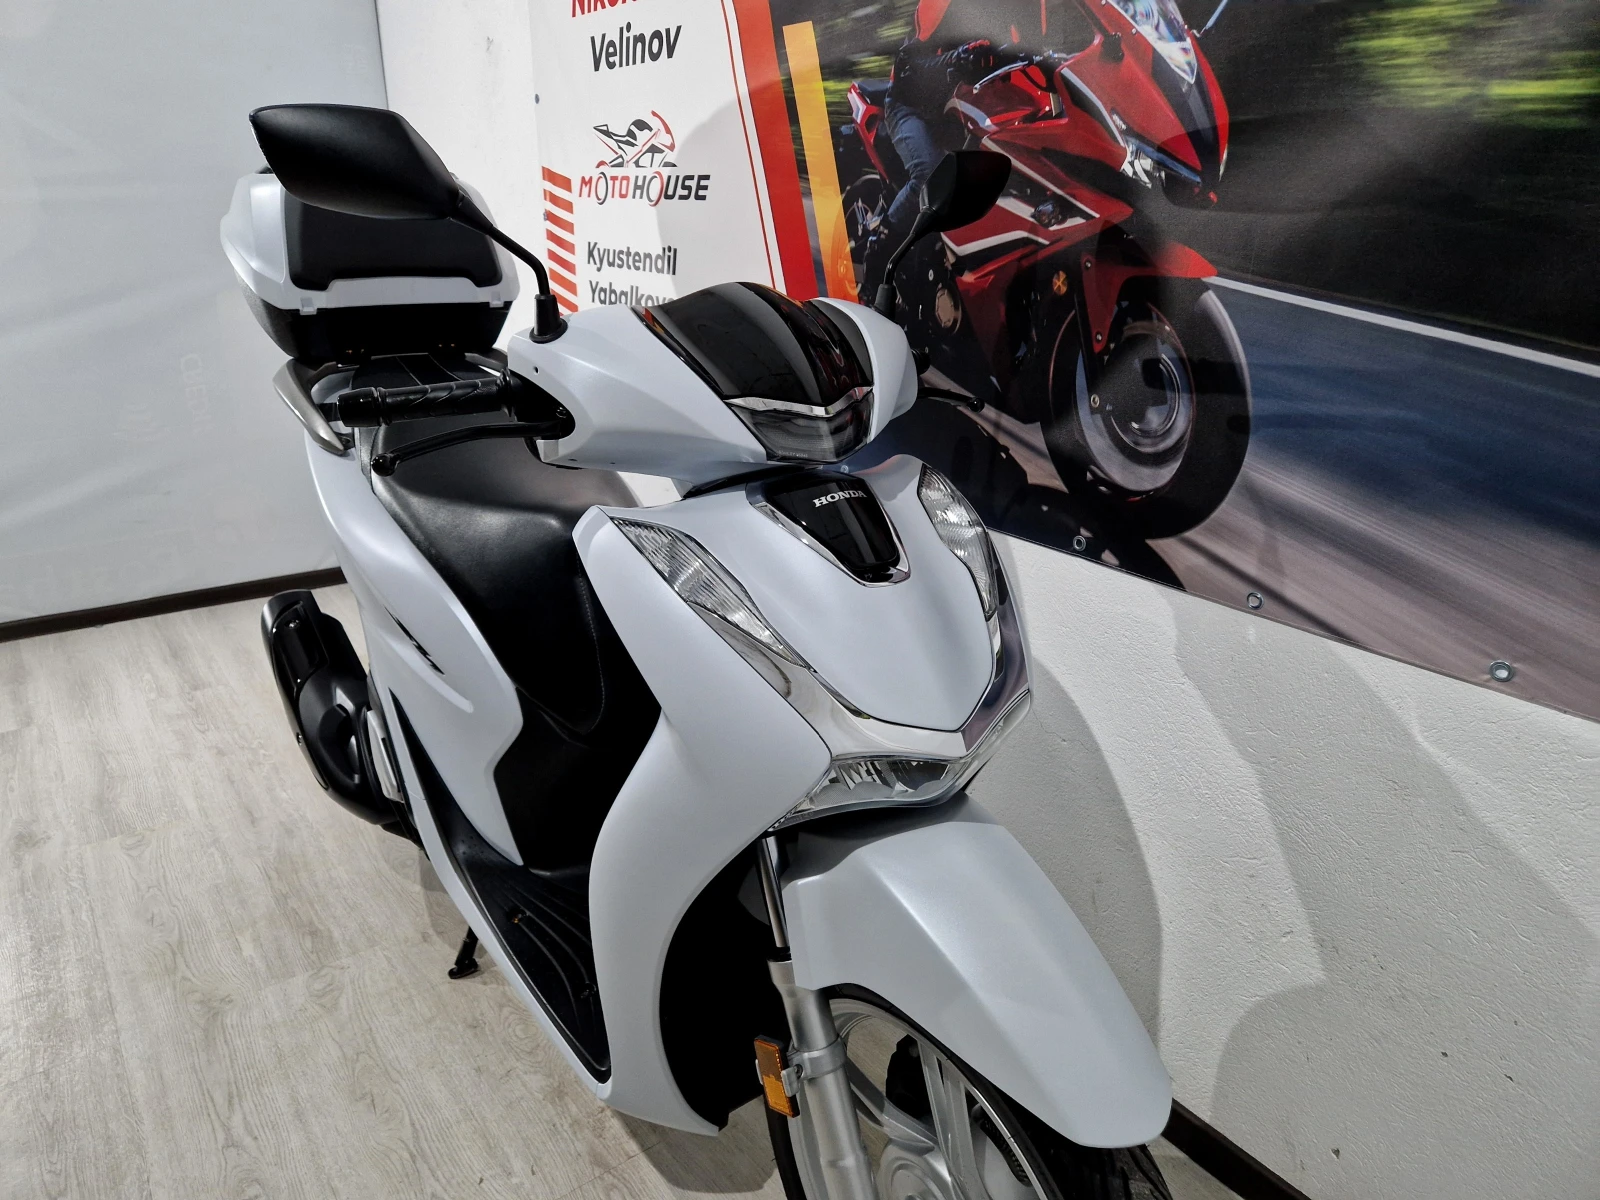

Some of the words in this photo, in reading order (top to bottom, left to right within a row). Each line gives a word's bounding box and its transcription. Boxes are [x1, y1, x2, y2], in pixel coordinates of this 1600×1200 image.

[590, 21, 682, 72] Velinov
[587, 241, 678, 276] Kyustendil
[588, 279, 676, 306] Yabalkov
[812, 490, 868, 508] HONDA
